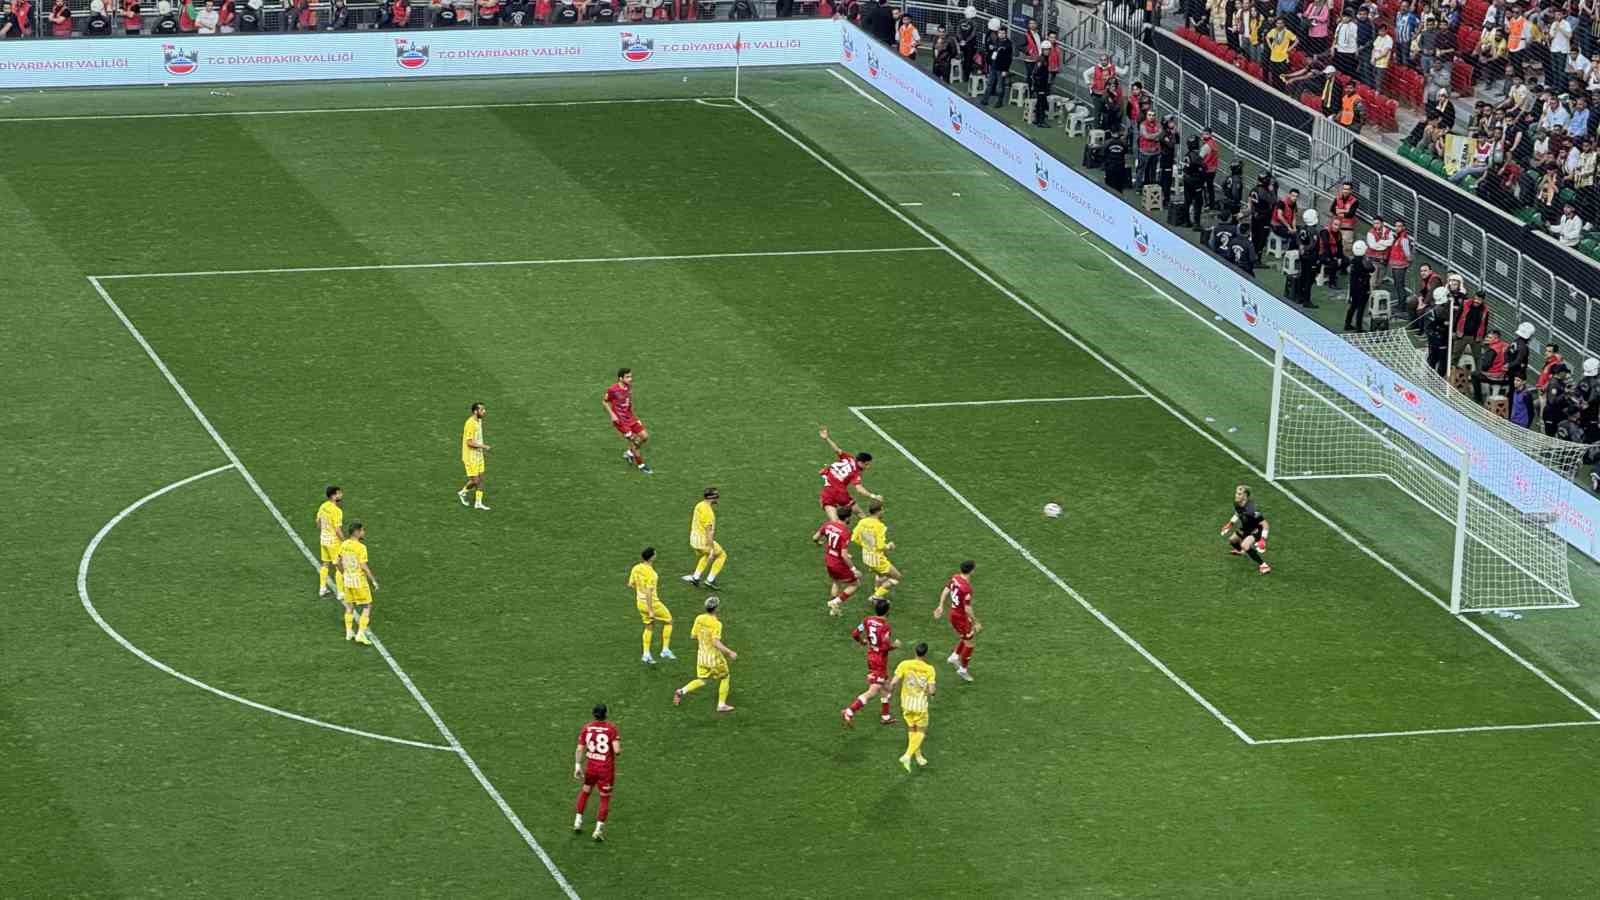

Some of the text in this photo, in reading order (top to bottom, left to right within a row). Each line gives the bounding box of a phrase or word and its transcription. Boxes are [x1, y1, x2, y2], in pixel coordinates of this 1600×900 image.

[681, 41, 751, 51] DİYARBAR
[868, 626, 877, 645] 5
[585, 733, 609, 753] 48
